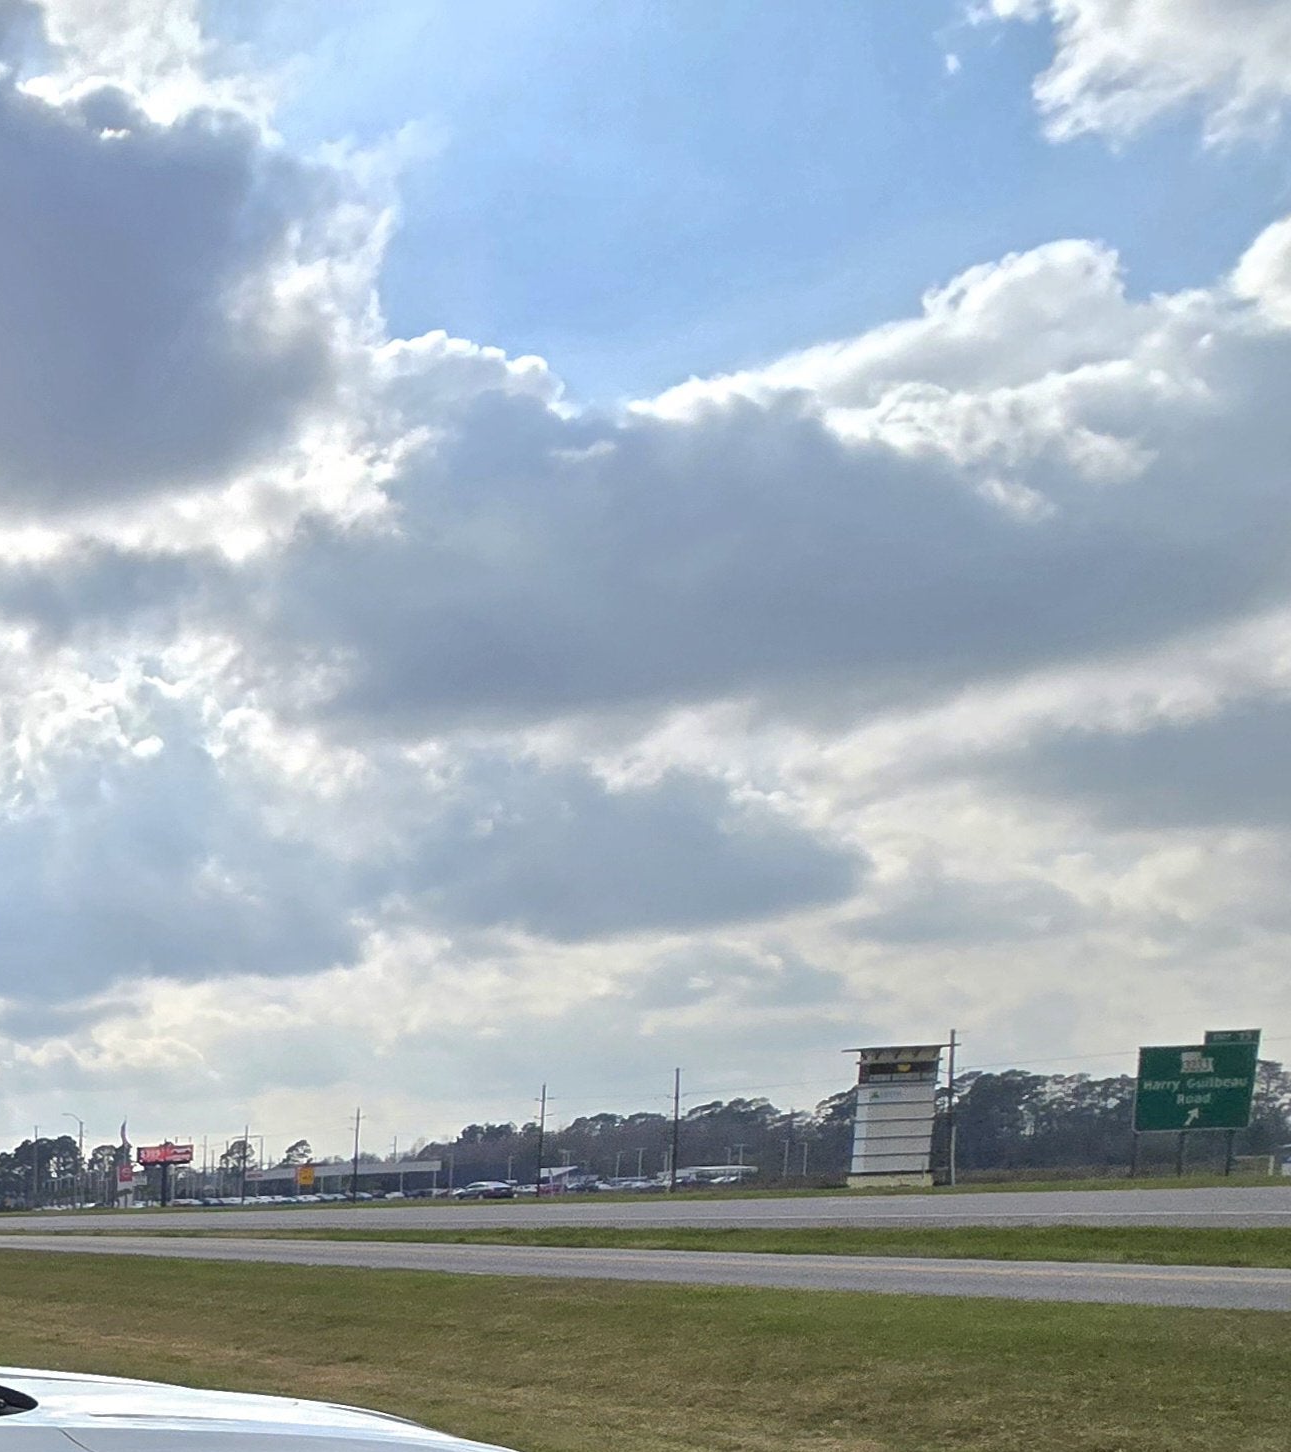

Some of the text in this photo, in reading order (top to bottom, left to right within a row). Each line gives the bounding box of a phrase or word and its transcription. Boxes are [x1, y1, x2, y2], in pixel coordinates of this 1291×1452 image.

[1143, 1077, 1248, 1093] Harry Guilbeau
[1176, 1092, 1212, 1105] Road
